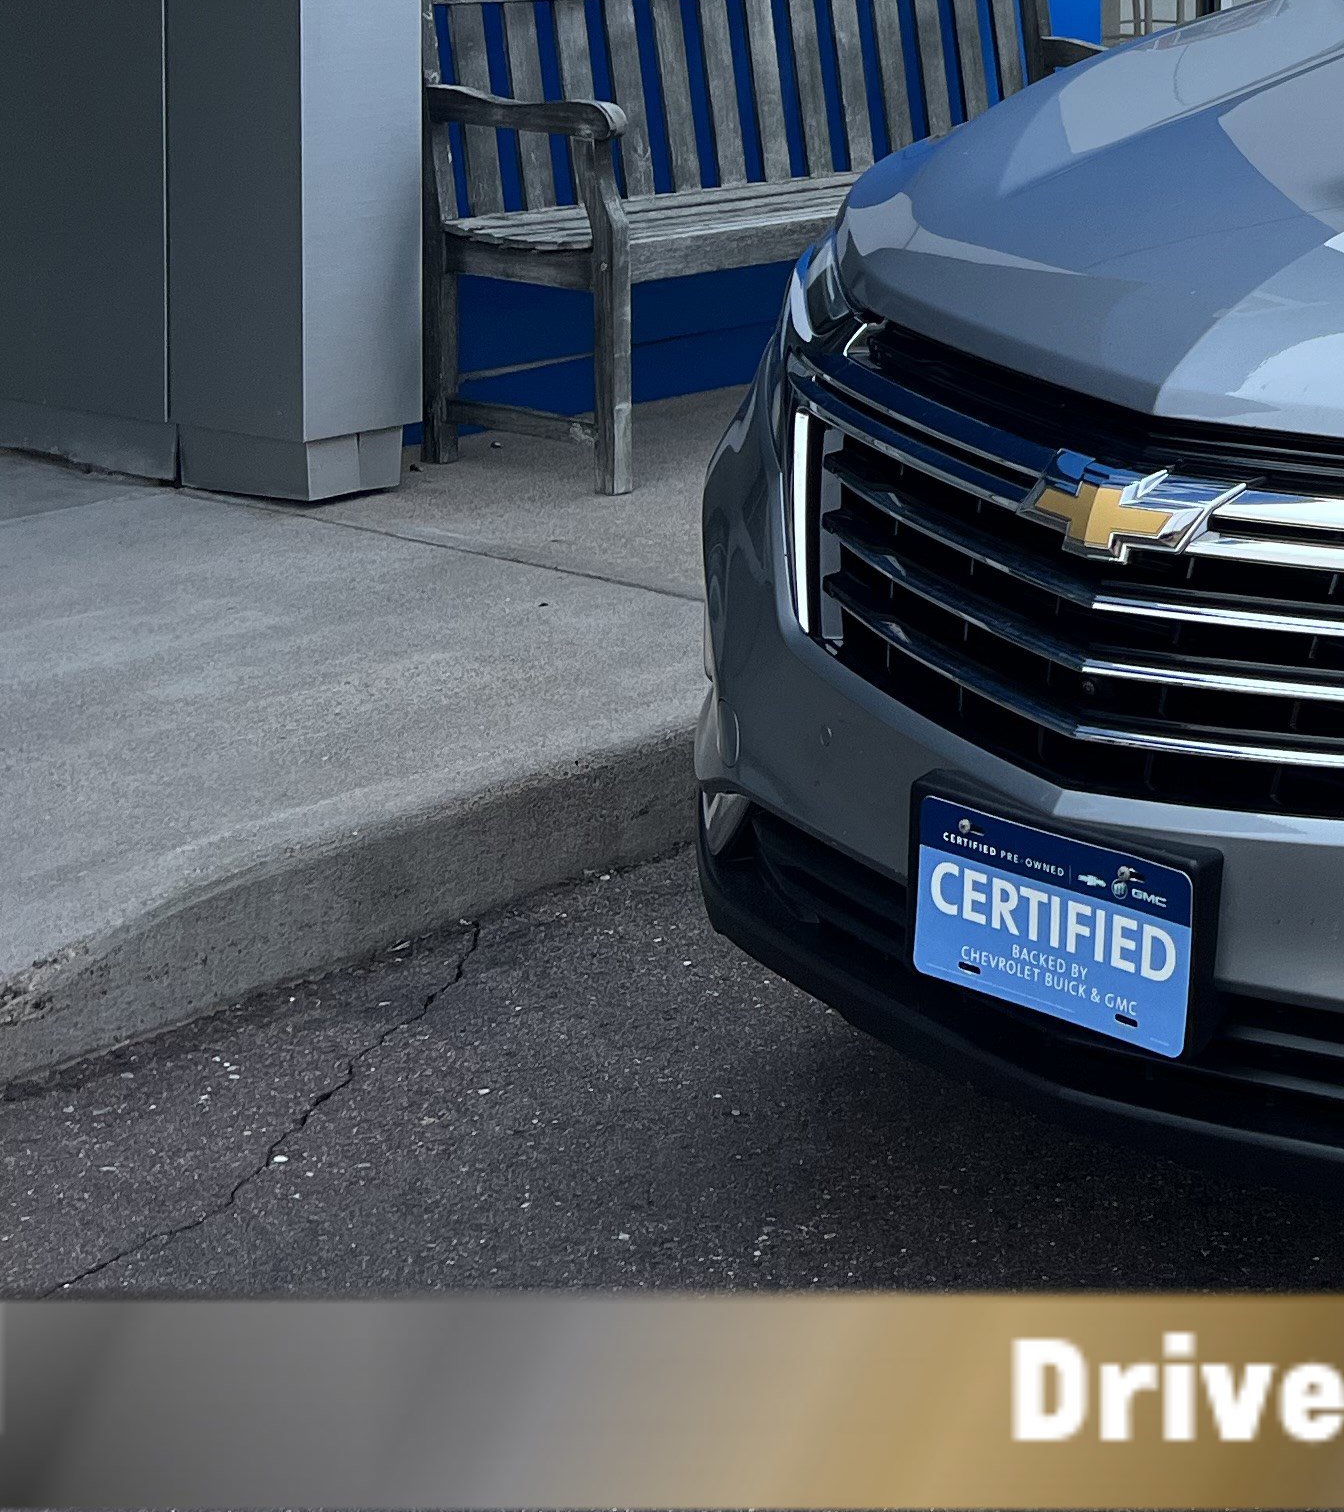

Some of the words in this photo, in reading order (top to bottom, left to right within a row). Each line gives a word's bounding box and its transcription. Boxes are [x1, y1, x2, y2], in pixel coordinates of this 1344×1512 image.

[942, 831, 997, 857] CERTIFIED
[1131, 888, 1167, 908] GMC
[930, 861, 1177, 982] CERTIFIED
[961, 945, 1041, 983] CHEVROLET
[1045, 972, 1086, 999] BUICK
[1090, 987, 1101, 1003] &
[1104, 993, 1138, 1016] GMC
[1012, 944, 1066, 973] BACKED
[1071, 963, 1088, 981] BY
